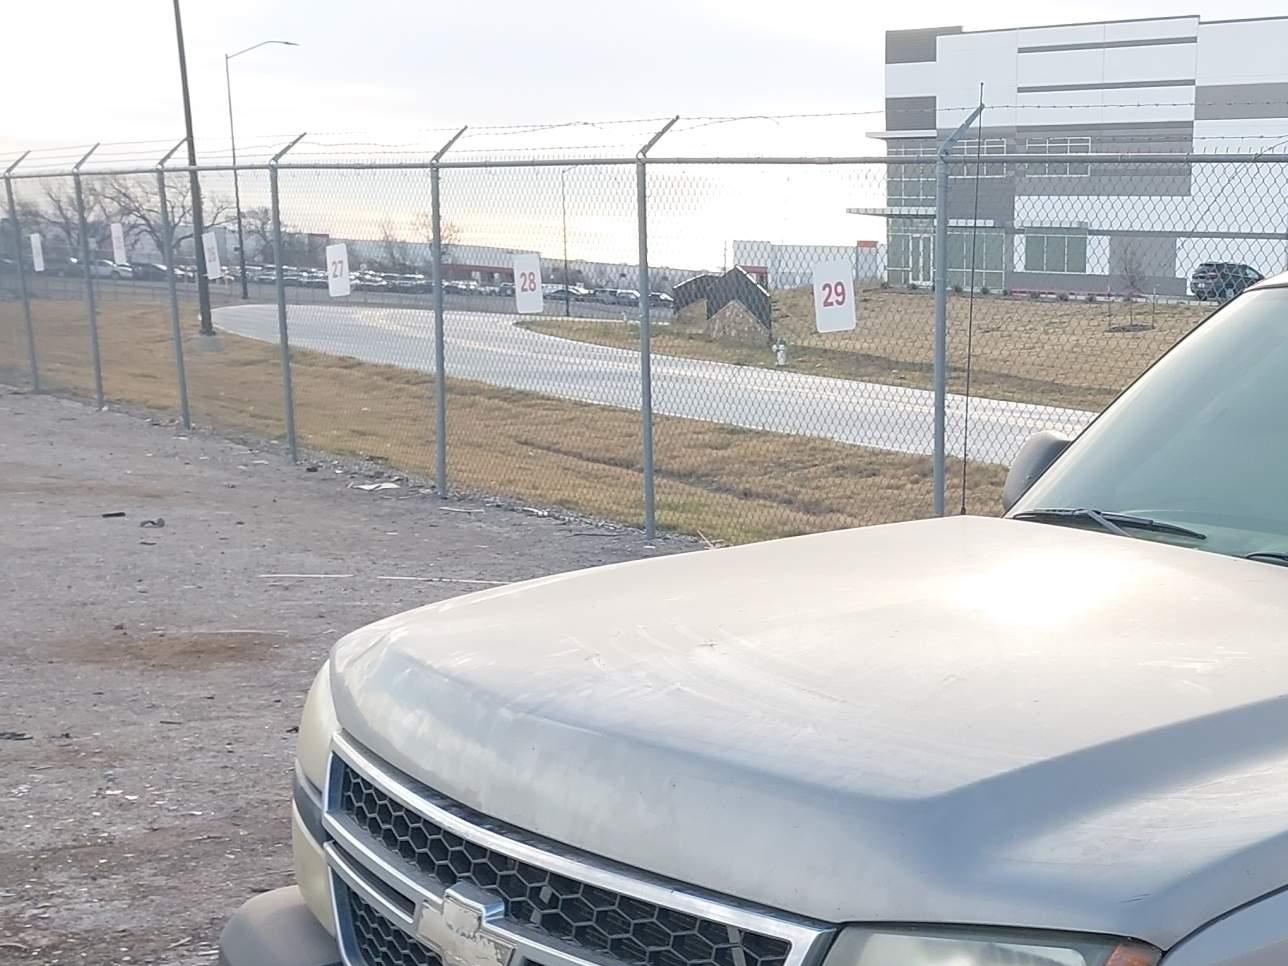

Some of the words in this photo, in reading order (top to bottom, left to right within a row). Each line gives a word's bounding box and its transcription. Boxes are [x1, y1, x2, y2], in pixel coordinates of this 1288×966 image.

[331, 260, 344, 278] 27
[519, 272, 537, 292] 28
[821, 281, 846, 307] 29
